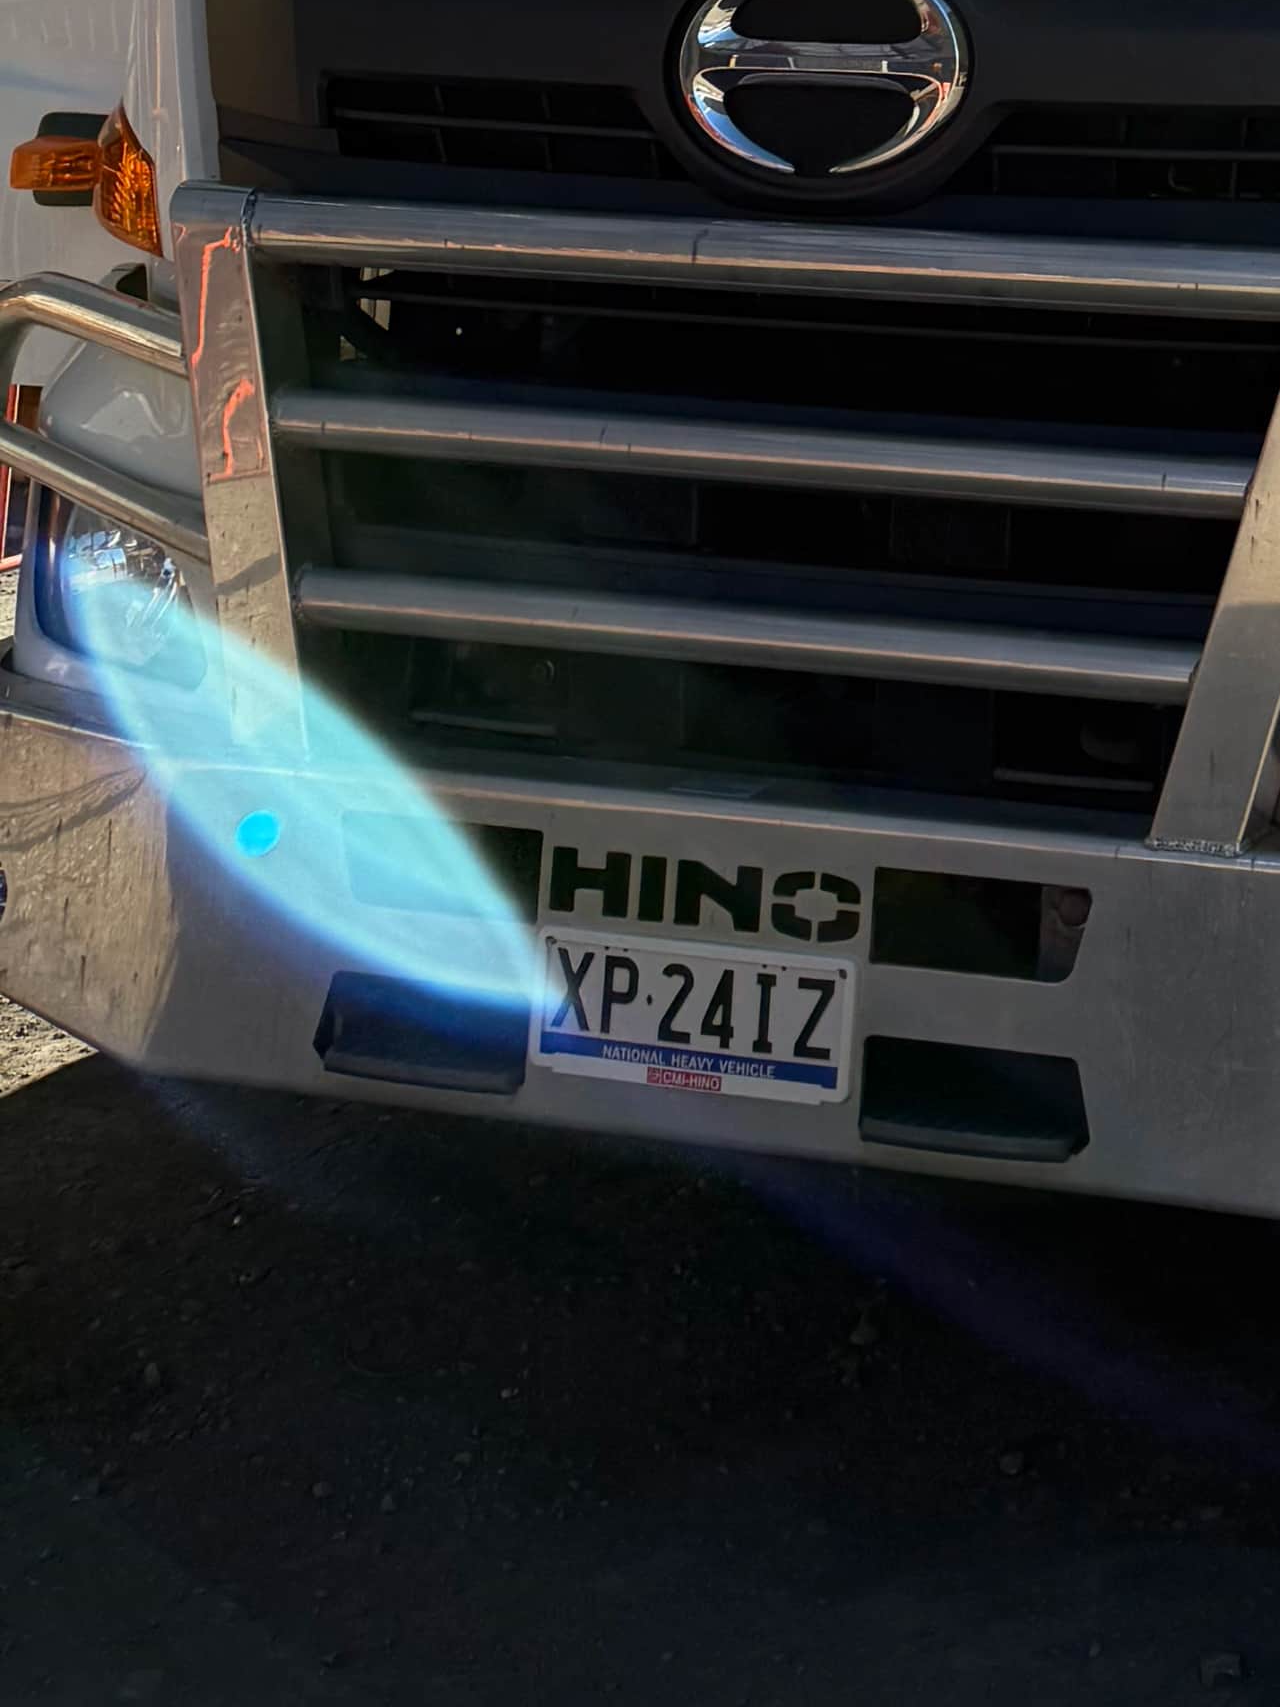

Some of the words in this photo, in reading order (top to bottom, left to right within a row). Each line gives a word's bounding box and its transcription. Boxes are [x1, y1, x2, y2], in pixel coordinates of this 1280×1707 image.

[549, 845, 862, 944] HINO
[601, 1044, 664, 1066] NATIONAL
[671, 1052, 716, 1073] HEAVY
[719, 1058, 776, 1078] VEHICLE
